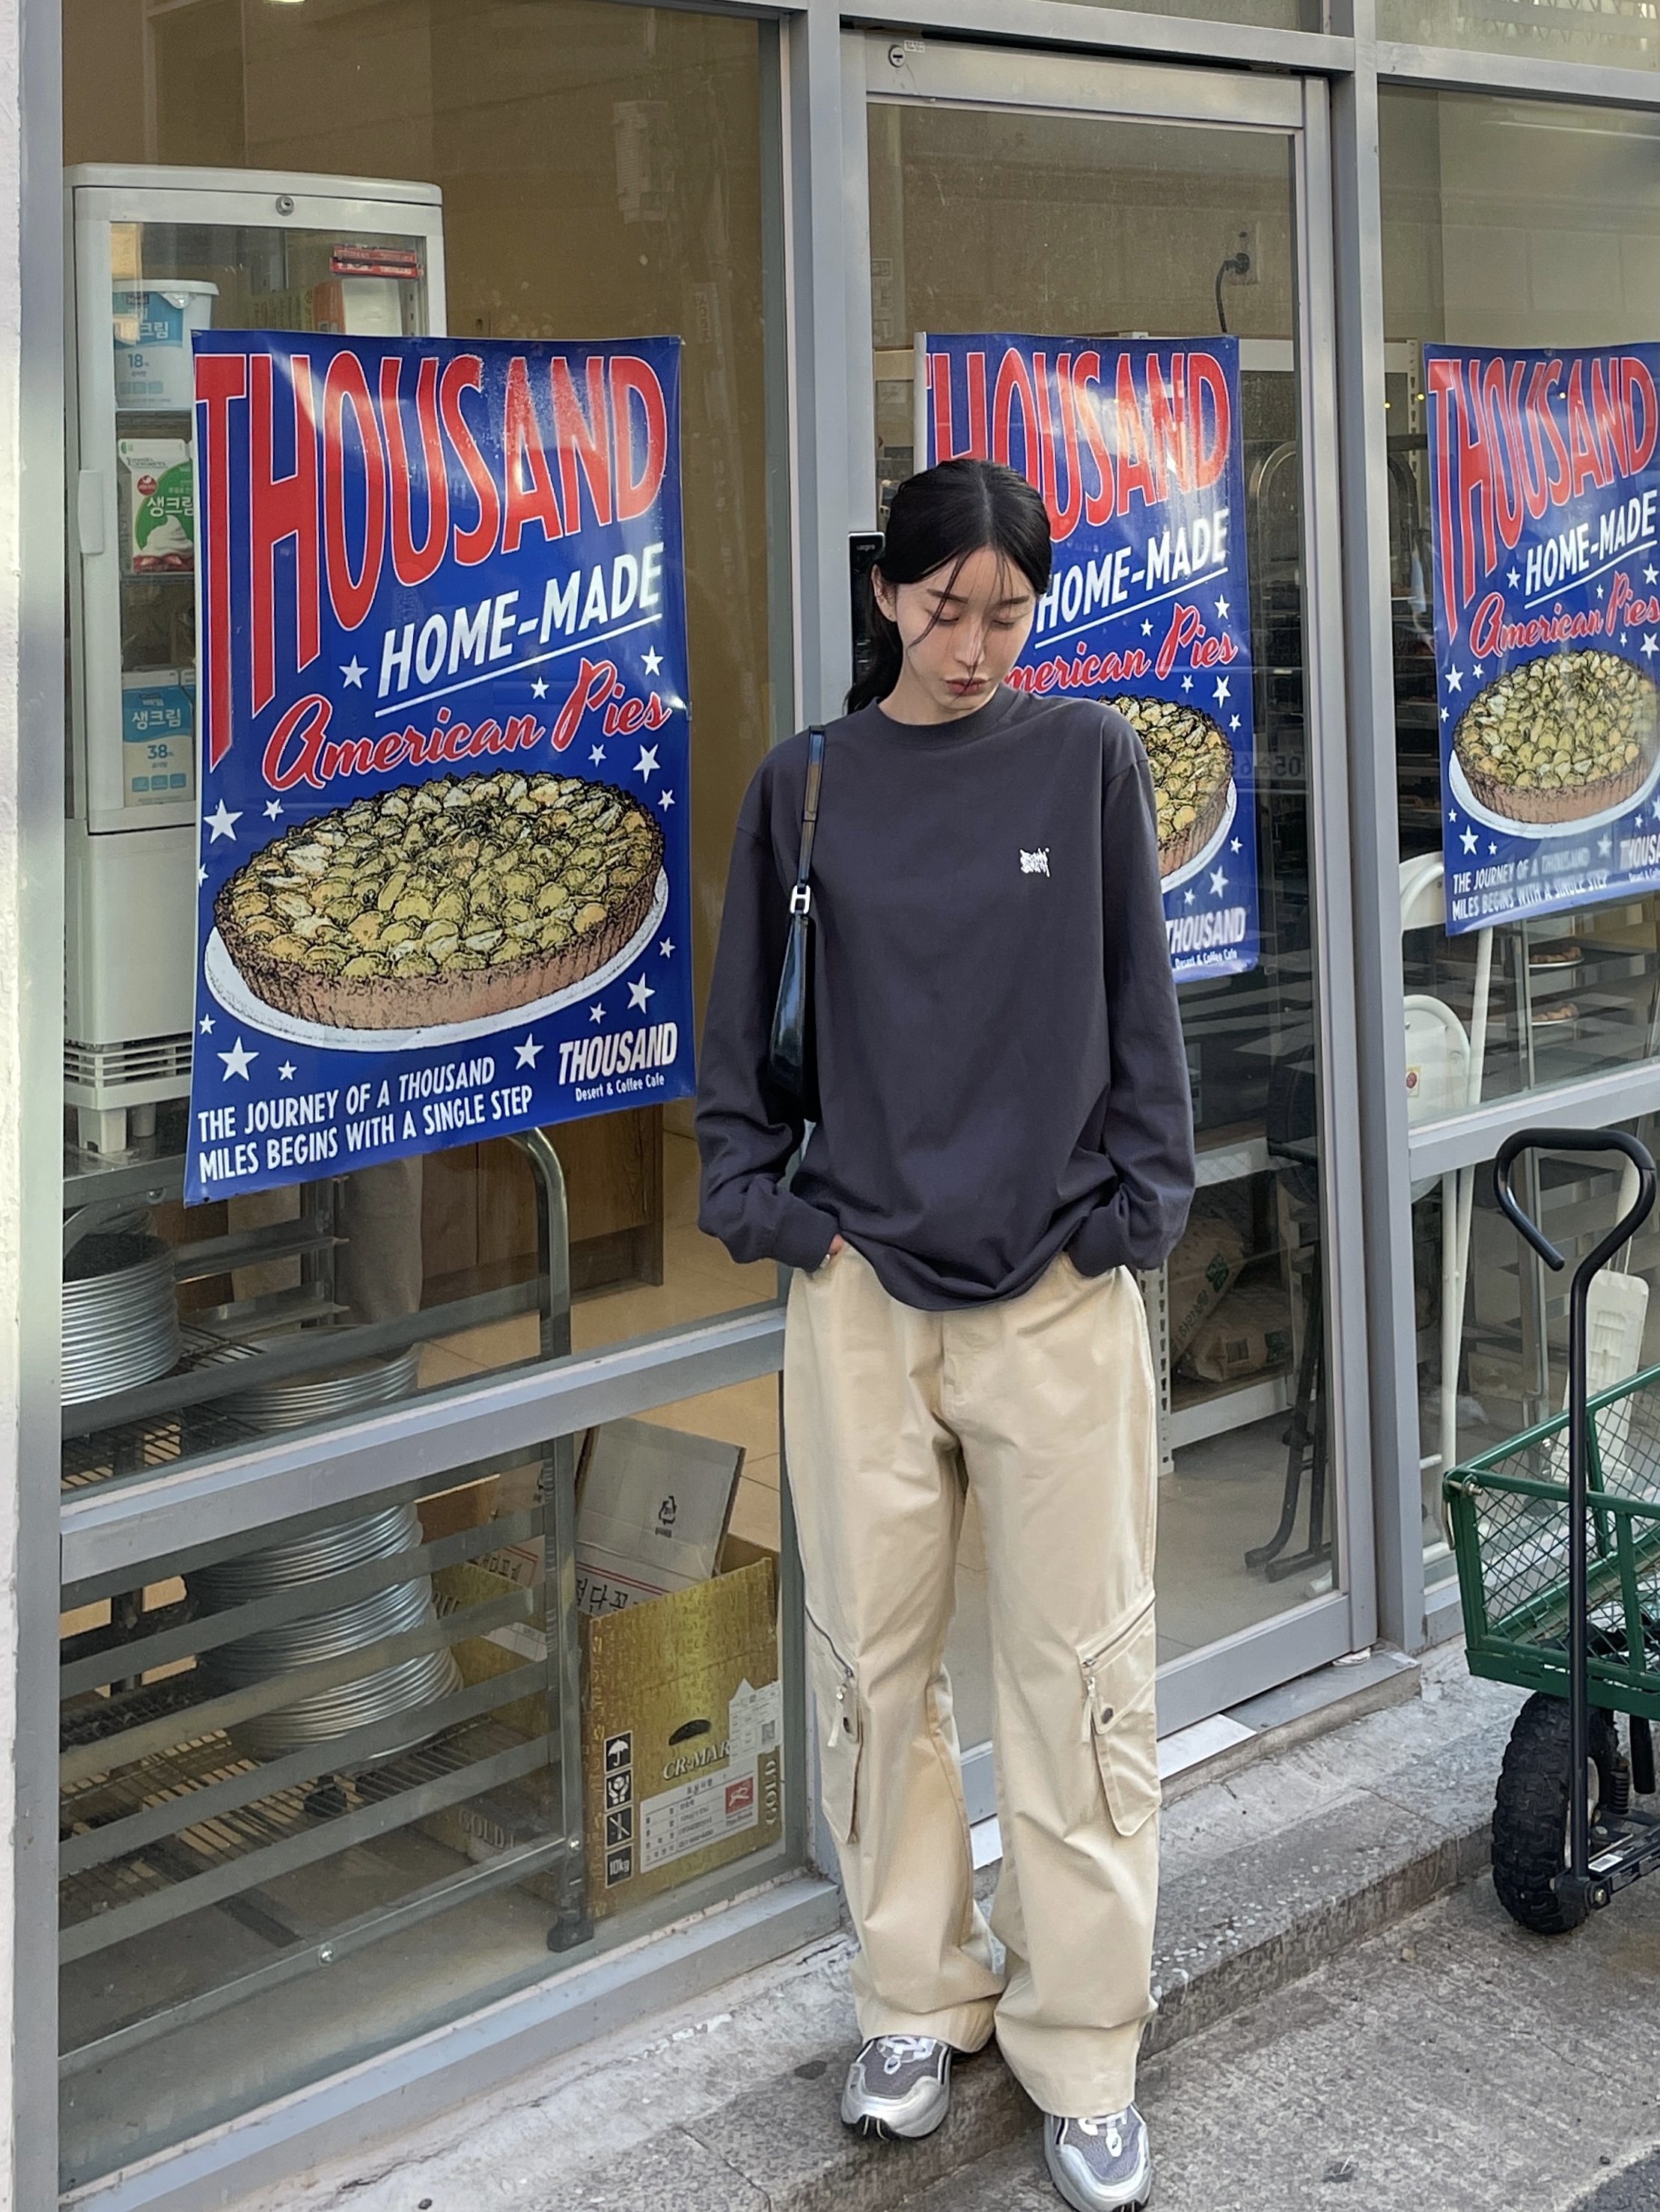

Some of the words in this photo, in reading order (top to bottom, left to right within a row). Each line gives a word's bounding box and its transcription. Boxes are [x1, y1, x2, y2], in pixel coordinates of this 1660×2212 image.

[926, 347, 1231, 543] OUSAND
[1428, 356, 1659, 645] THOUSAND
[1525, 489, 1658, 596] HOME-MADE
[195, 350, 668, 774] THOUSAND
[1036, 507, 1229, 633] HOME-MADE
[378, 542, 665, 698] HOME-MADE
[1004, 641, 1152, 694] merican
[1155, 602, 1239, 679] Pies
[1470, 591, 1603, 659] American
[1605, 569, 1660, 637] Pies
[132, 708, 181, 730] 생크림
[261, 693, 546, 790] American
[551, 657, 673, 752] Pies
[1452, 896, 1479, 921] MILES
[1453, 871, 1471, 894] THE
[1473, 861, 1516, 890] JOURNEY
[1165, 907, 1247, 954] THOUSAND
[558, 1022, 678, 1085] THOUSAND
[575, 1084, 604, 1102] Desert
[606, 1082, 614, 1096] &
[616, 1078, 643, 1093] Coffee
[645, 1072, 665, 1088] Cafe
[198, 1106, 237, 1143] THE
[244, 1089, 339, 1134] JOURNEY
[346, 1083, 371, 1115] OF
[376, 1080, 390, 1108] A
[399, 1057, 495, 1102] THOUSAND
[199, 1141, 259, 1184] MILES
[266, 1126, 338, 1170] BEGINS
[346, 1113, 395, 1152] WITH
[402, 1110, 418, 1140] A
[422, 1093, 486, 1136] SINGLE
[491, 1084, 533, 1120] STEP
